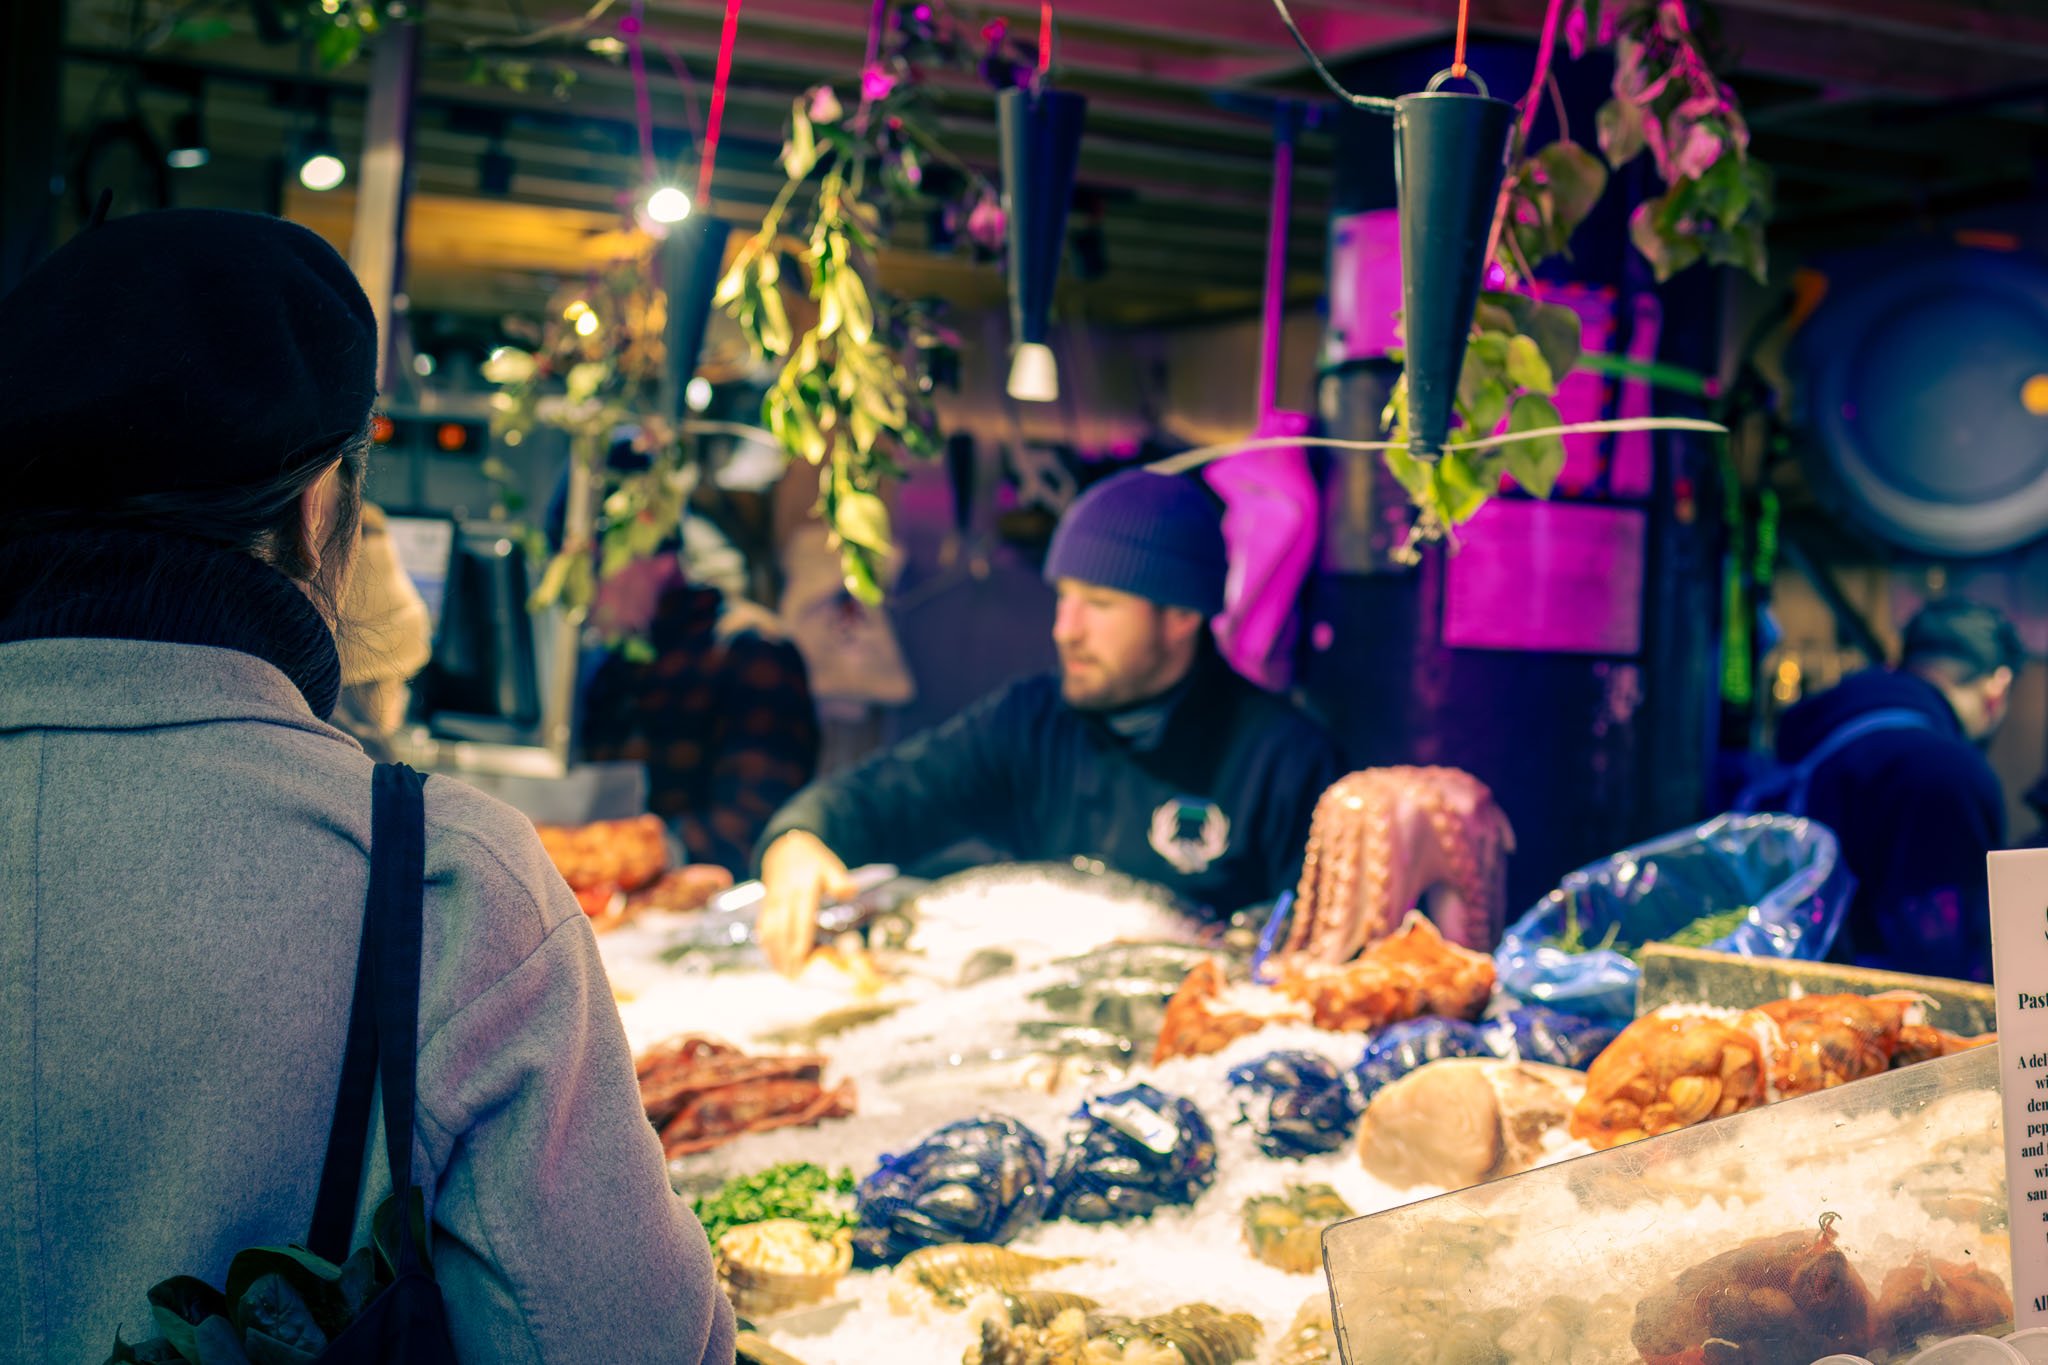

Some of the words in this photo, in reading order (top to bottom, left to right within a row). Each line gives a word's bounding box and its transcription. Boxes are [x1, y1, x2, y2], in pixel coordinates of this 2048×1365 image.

[2017, 1055, 2026, 1069] A
[2029, 1053, 2047, 1068] del
[2021, 1142, 2044, 1158] and
[2034, 1163, 2048, 1178] wi
[2026, 1190, 2047, 1202] sau
